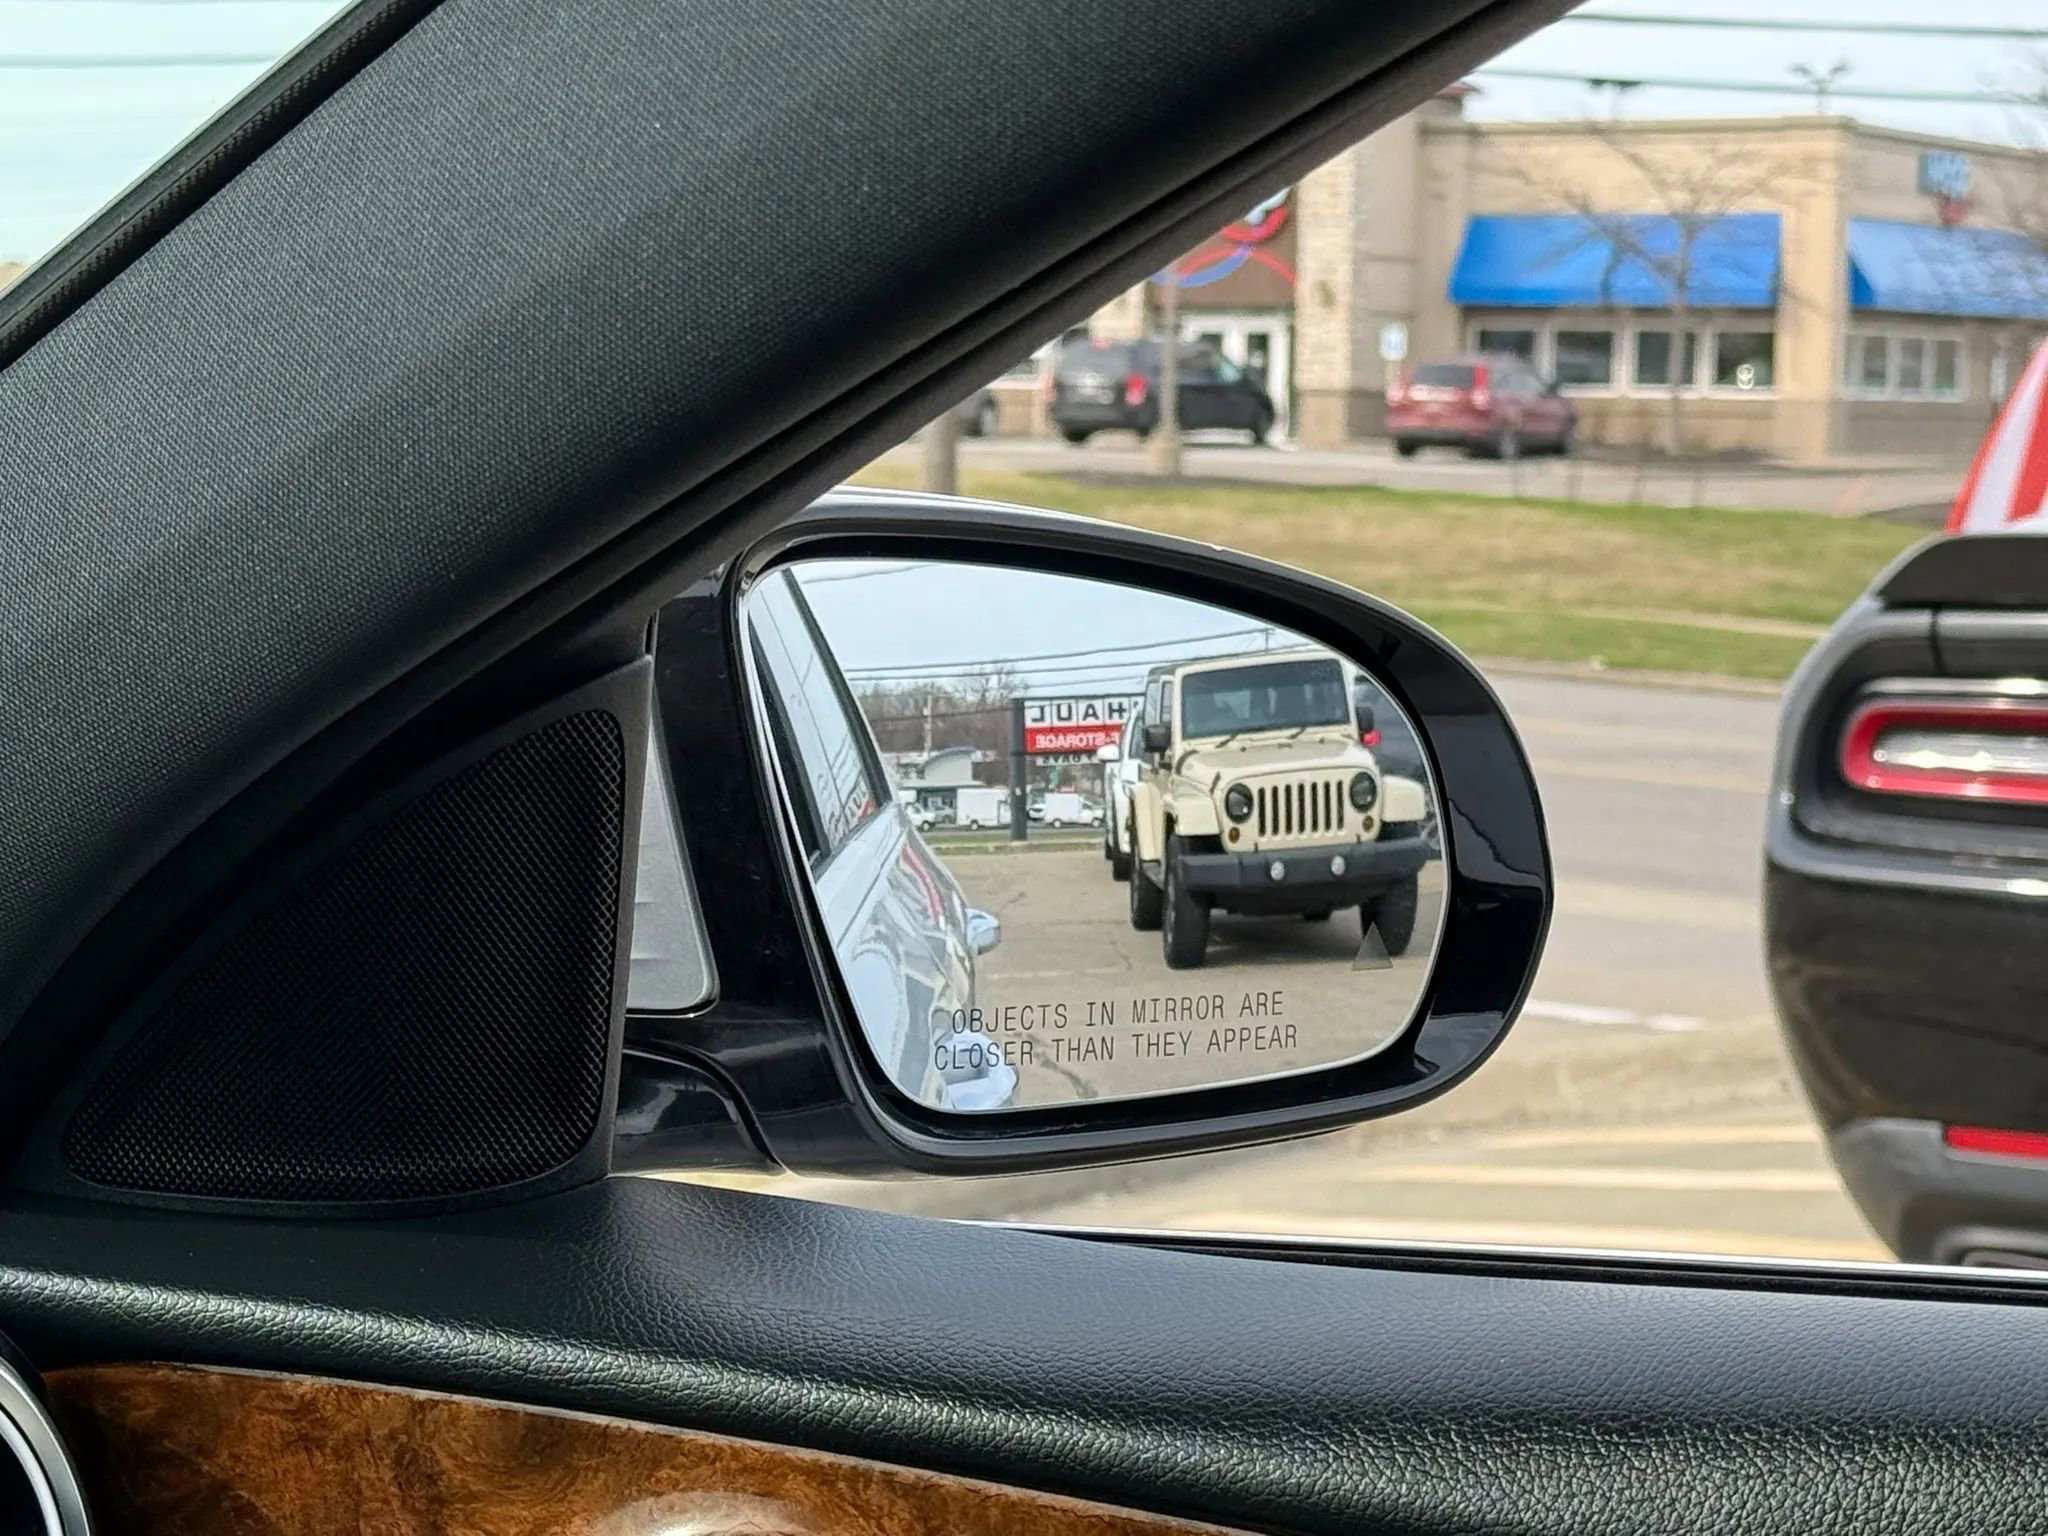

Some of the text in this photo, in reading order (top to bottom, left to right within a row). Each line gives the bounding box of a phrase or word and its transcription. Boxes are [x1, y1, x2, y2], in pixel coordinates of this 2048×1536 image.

[952, 991, 1284, 1034] OBJECTS IN MIRROR ARE
[935, 1024, 1298, 1071] CLOSER THAN THEY APPEAR
